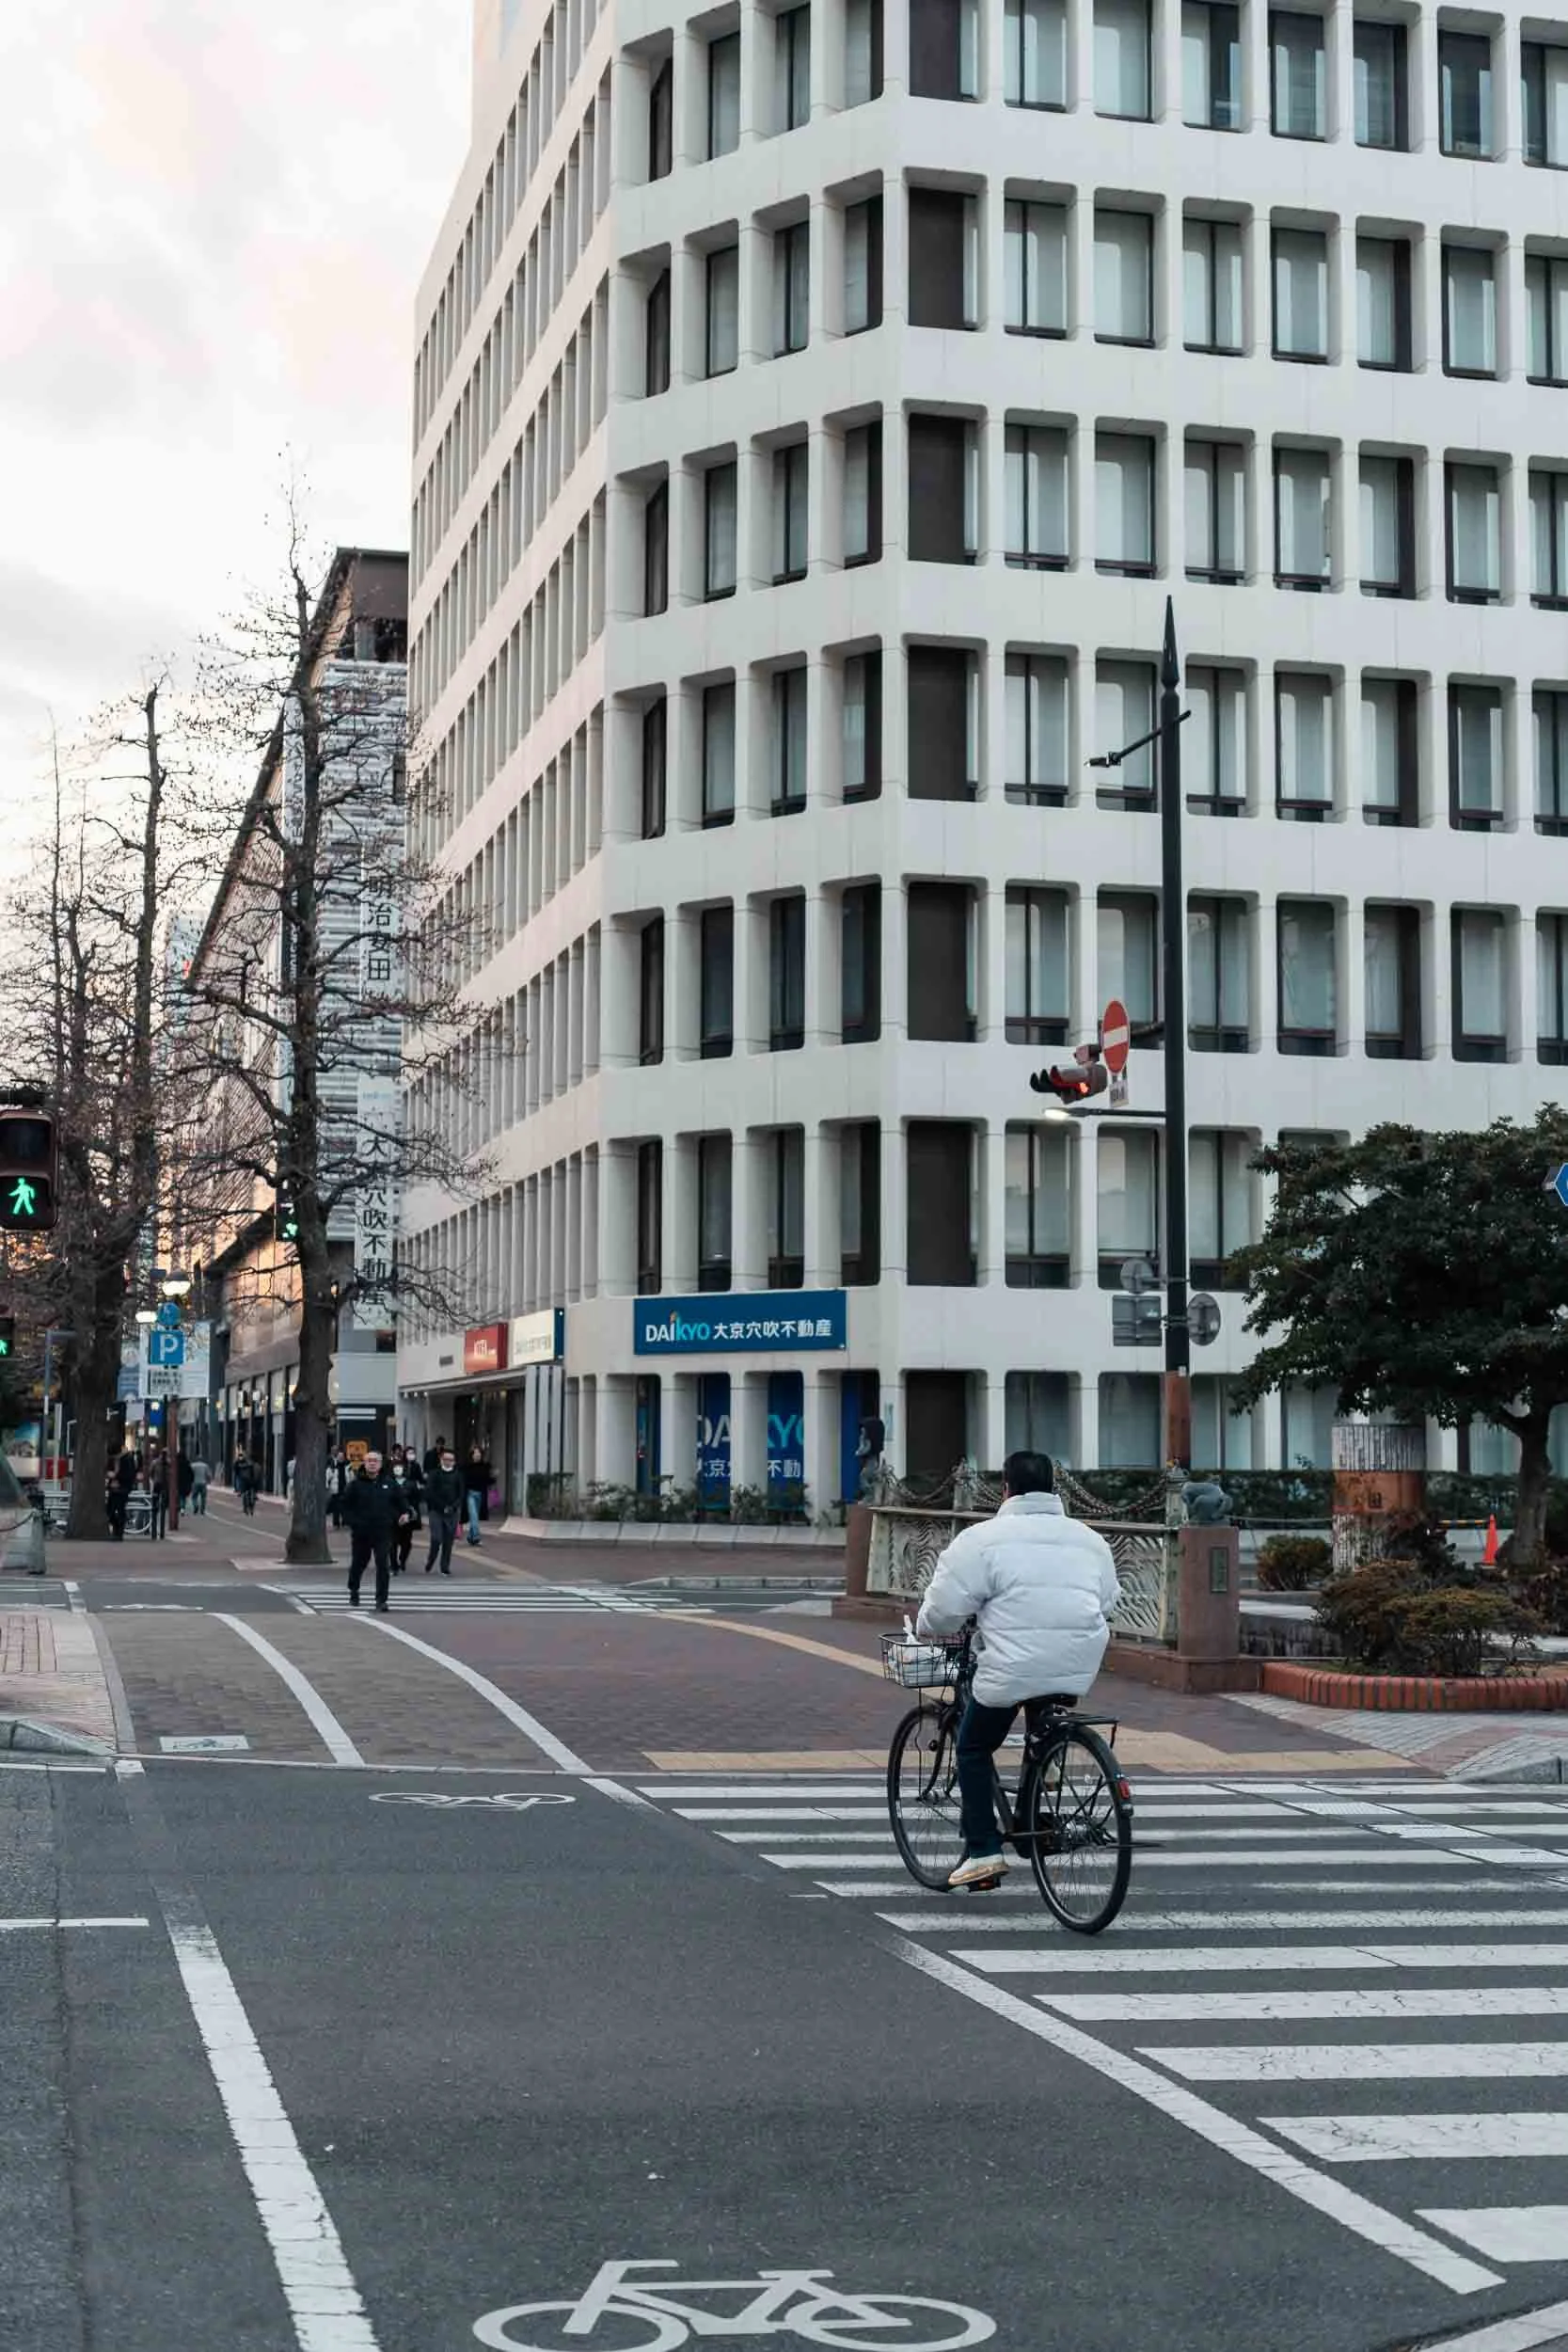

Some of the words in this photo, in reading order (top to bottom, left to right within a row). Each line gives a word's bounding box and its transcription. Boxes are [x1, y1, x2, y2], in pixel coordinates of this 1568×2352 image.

[361, 1136, 388, 1306] 大穴吹不動産
[712, 1318, 832, 1340] 大京穴吹不動産
[159, 1333, 180, 1361] P
